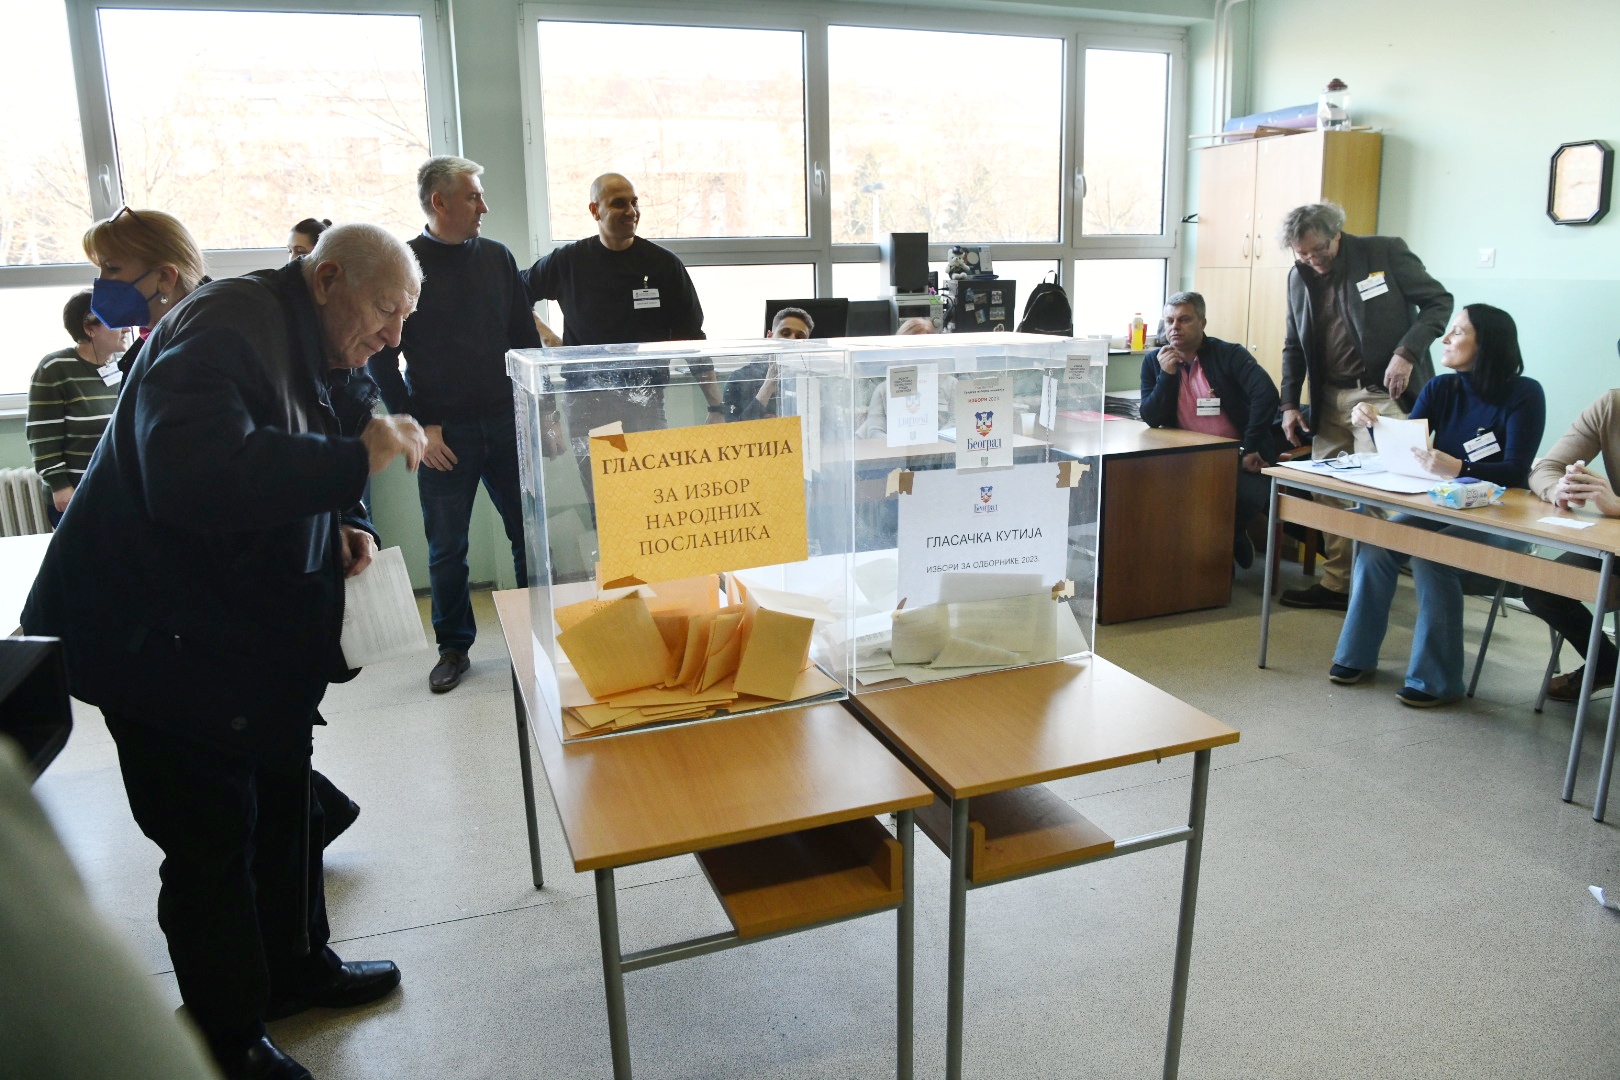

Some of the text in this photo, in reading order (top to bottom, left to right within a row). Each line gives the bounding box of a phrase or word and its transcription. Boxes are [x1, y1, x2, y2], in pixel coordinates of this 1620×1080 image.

[601, 439, 793, 475] ГЛАСАЧКА КУТИЈА
[967, 438, 1002, 451] Београд
[653, 478, 750, 504] ЗА ИЗБОР
[646, 501, 762, 530] НАРОДНИХ
[639, 525, 771, 556] ПОСЛАНИКА
[926, 527, 1042, 548] ГЛАСАЧКА КУТИЈА
[926, 563, 959, 573] ИЗБОРИ
[960, 561, 971, 569] ЗА
[973, 557, 1020, 568] ОДБОРНИКЕ
